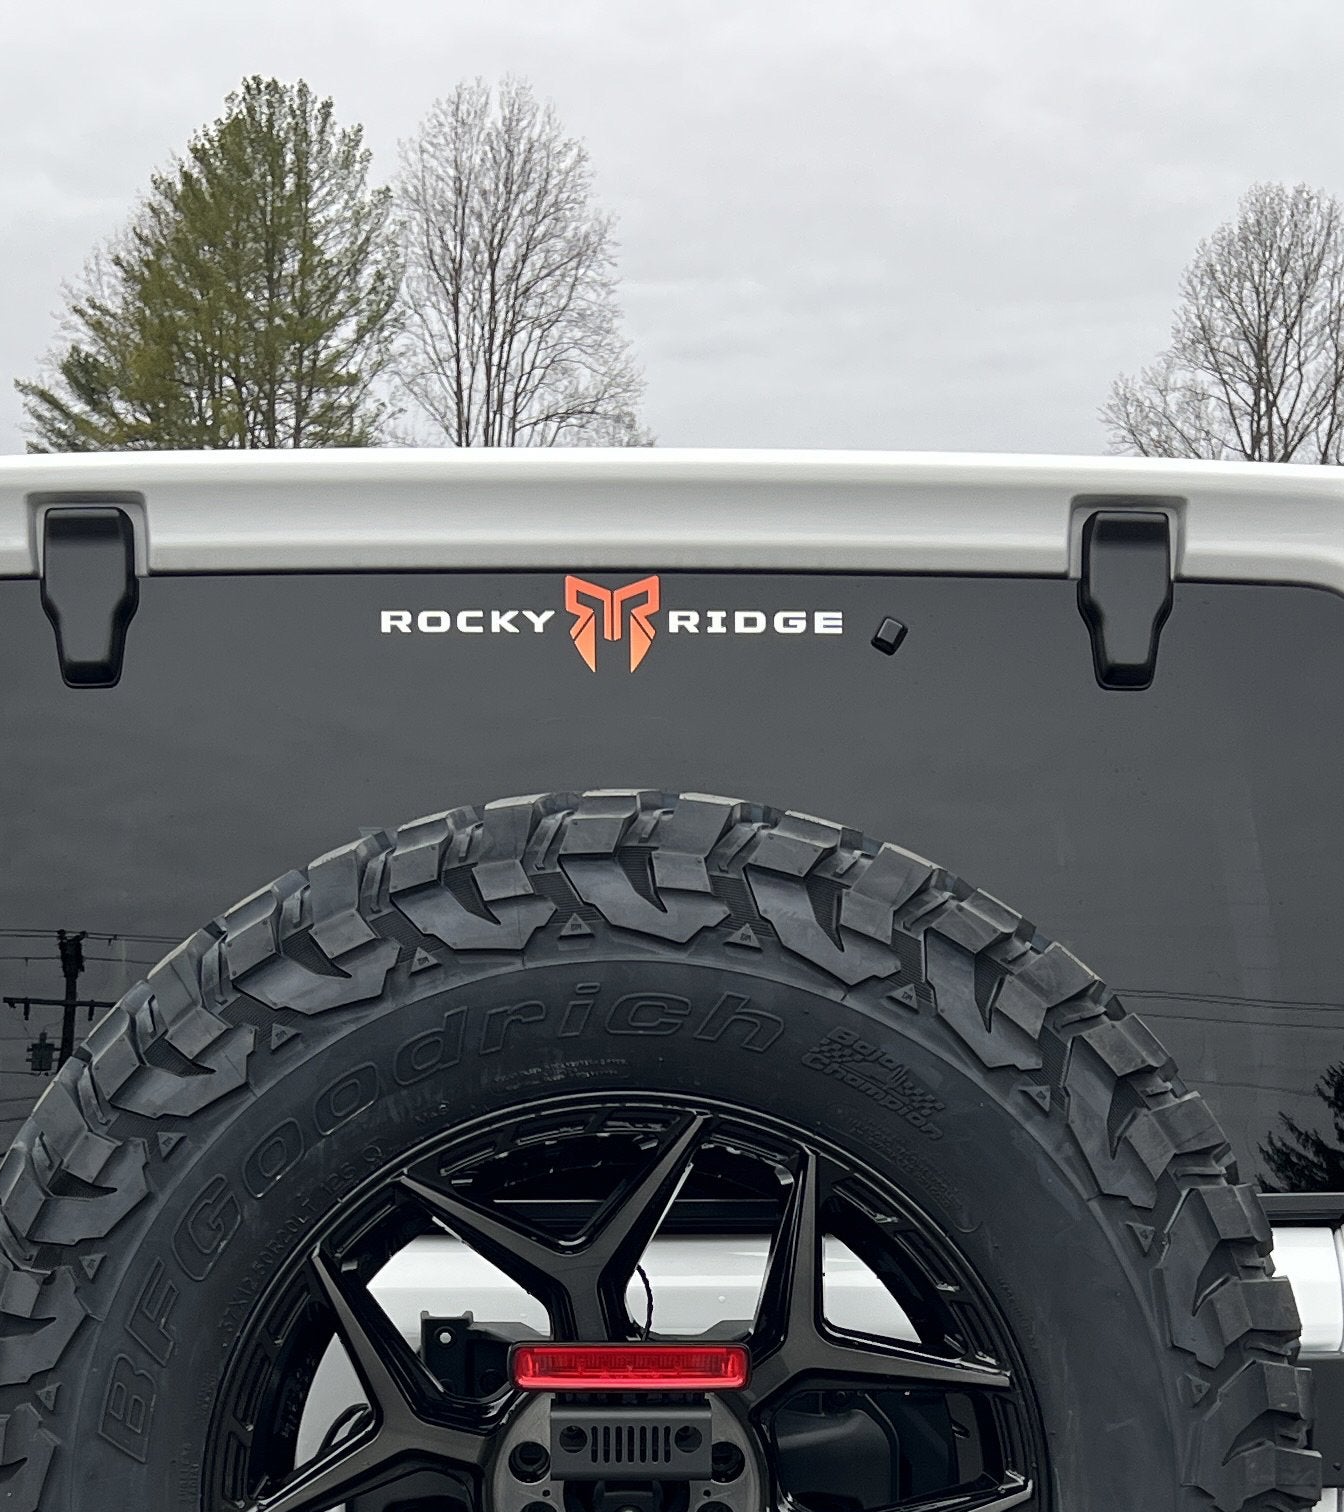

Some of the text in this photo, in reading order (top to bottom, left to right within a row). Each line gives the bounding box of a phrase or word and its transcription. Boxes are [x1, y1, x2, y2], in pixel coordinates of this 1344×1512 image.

[380, 609, 844, 635] ROCKY RIDGE
[827, 1026, 904, 1071] Baja
[801, 1053, 944, 1140] Champion
[97, 980, 788, 1463] BFGoodrich
